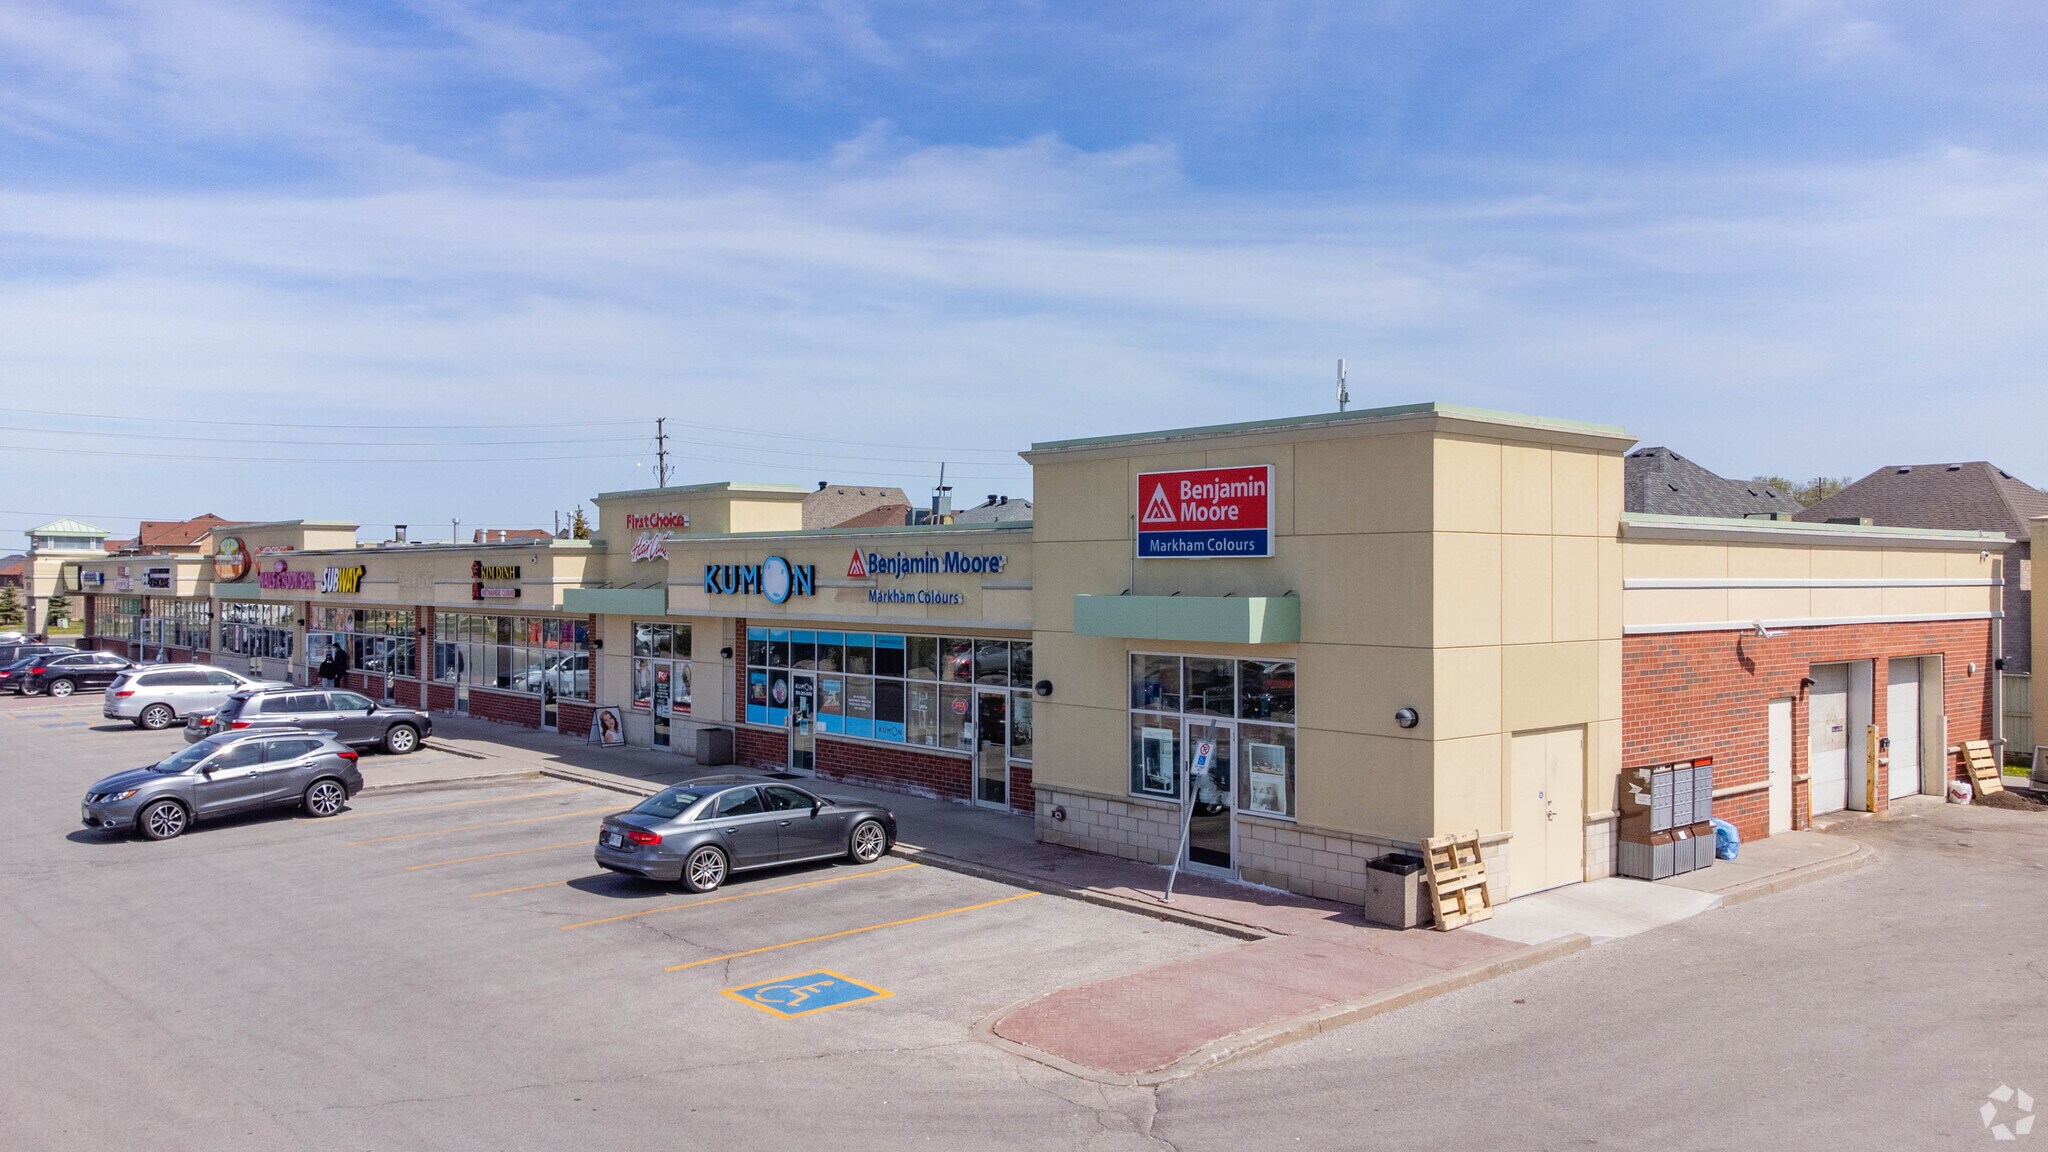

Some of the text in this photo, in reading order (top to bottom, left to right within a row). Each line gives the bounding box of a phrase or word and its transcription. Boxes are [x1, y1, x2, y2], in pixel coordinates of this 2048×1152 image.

[1180, 475, 1266, 505] Benjamin
[626, 511, 686, 529] First Choice
[1180, 501, 1239, 522] Moore
[1150, 537, 1255, 552] Markham Colours
[481, 566, 516, 580] KIM DINH
[868, 551, 1002, 580] Benjamin Moore
[321, 565, 364, 594] SUBWAY
[703, 555, 817, 605] KUMON
[868, 589, 960, 605] Markham Colours
[878, 726, 903, 736] KUMON
